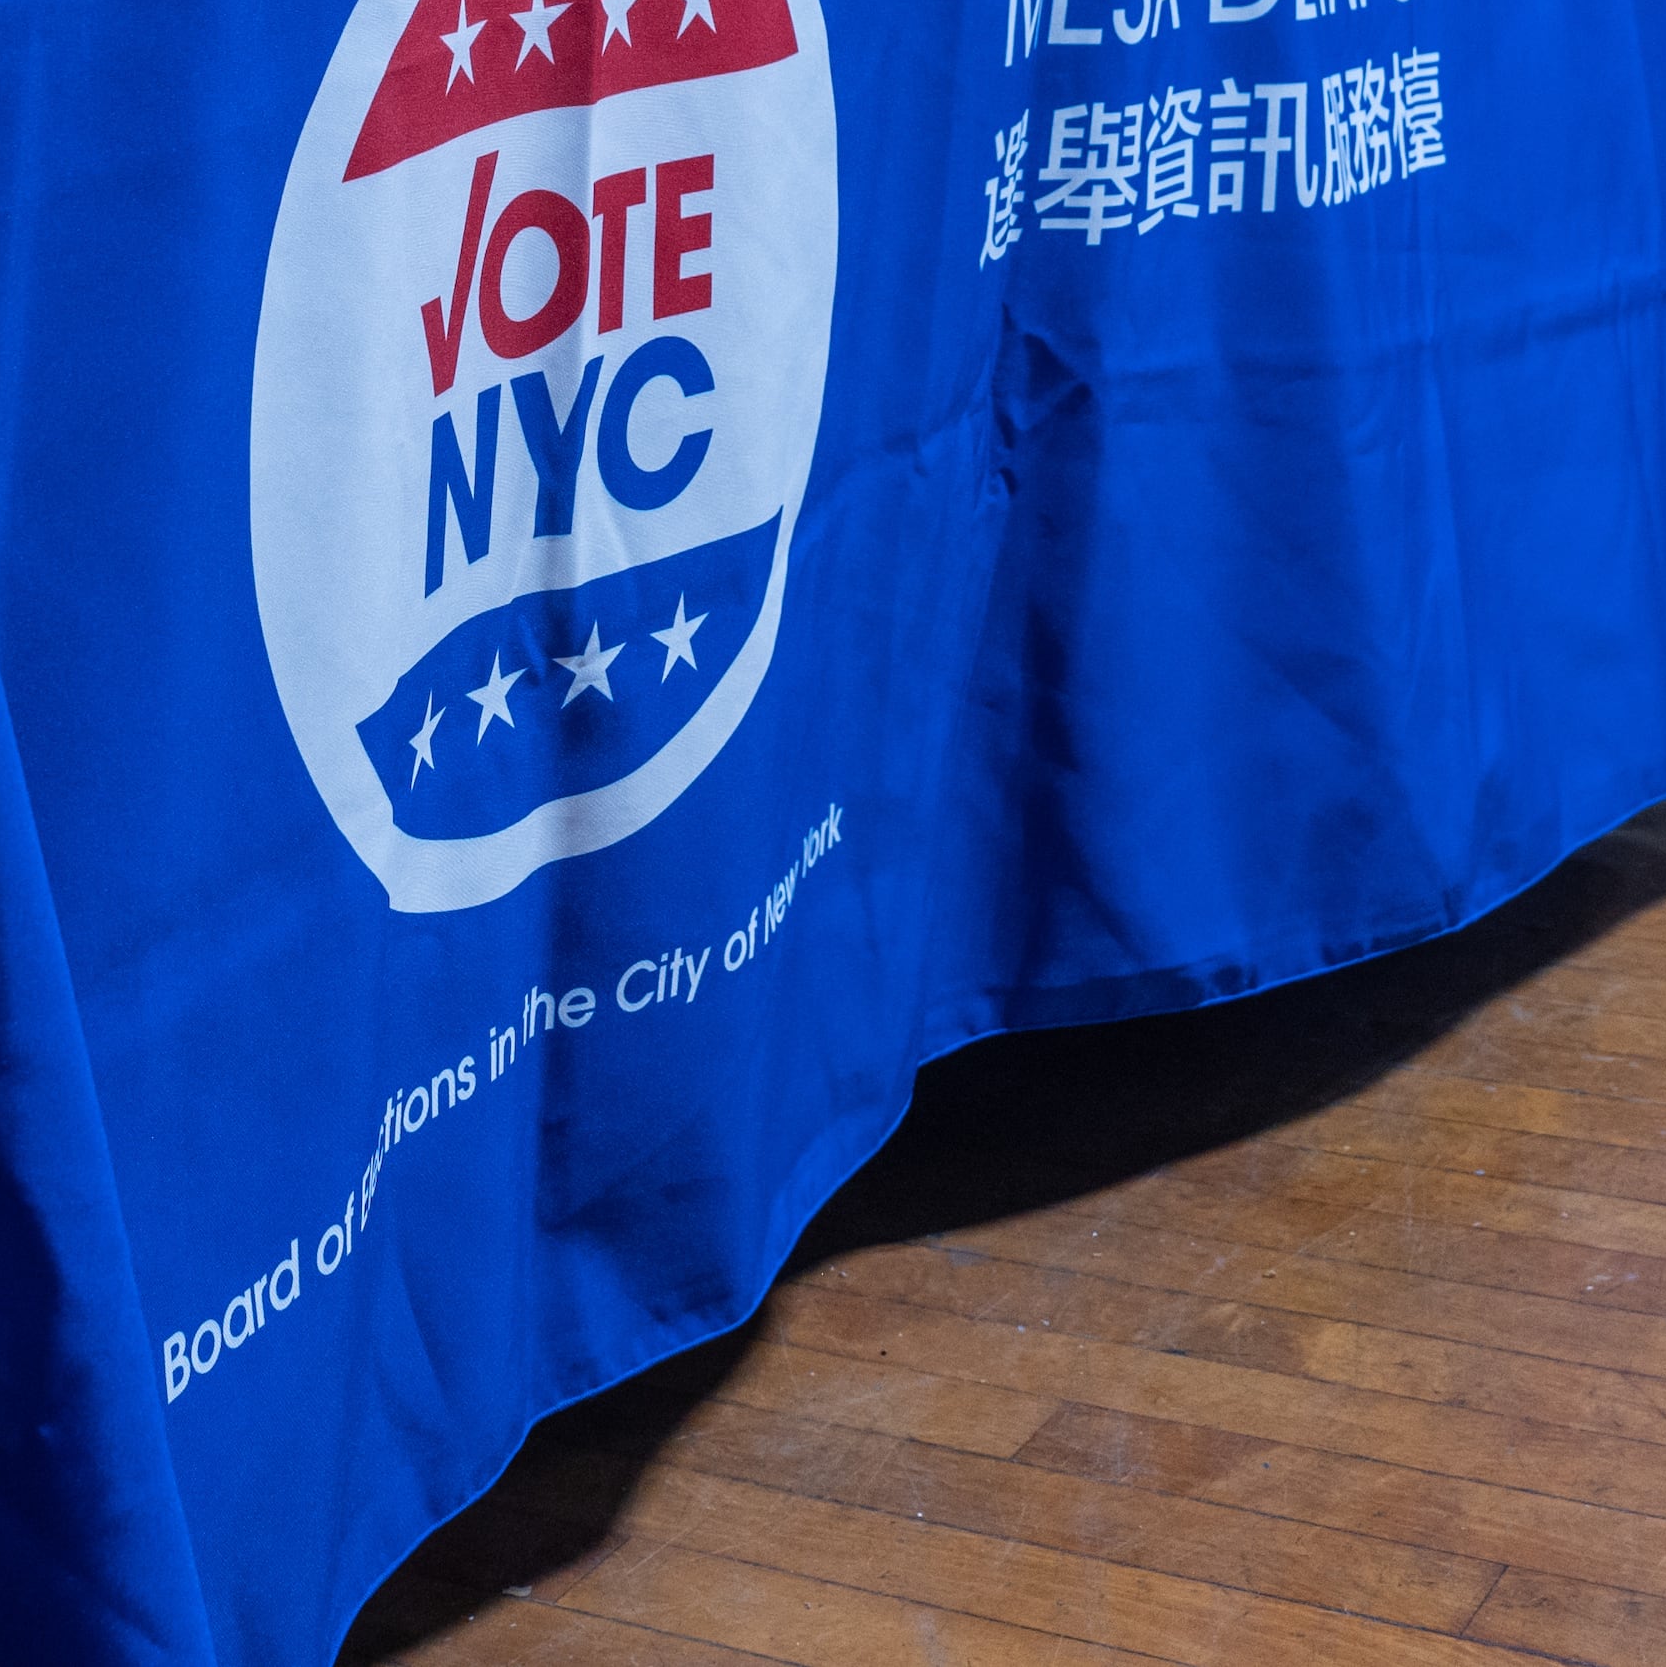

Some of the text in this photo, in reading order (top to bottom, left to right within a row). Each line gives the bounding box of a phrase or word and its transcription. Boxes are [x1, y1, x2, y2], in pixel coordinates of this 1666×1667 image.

[420, 150, 715, 397] VOTE
[424, 334, 716, 598] NYC
[163, 1239, 302, 1404] Board
[316, 1191, 356, 1277] of
[489, 1026, 516, 1082] in
[522, 985, 597, 1047] the
[615, 945, 710, 1014] City
[724, 906, 759, 972] of
